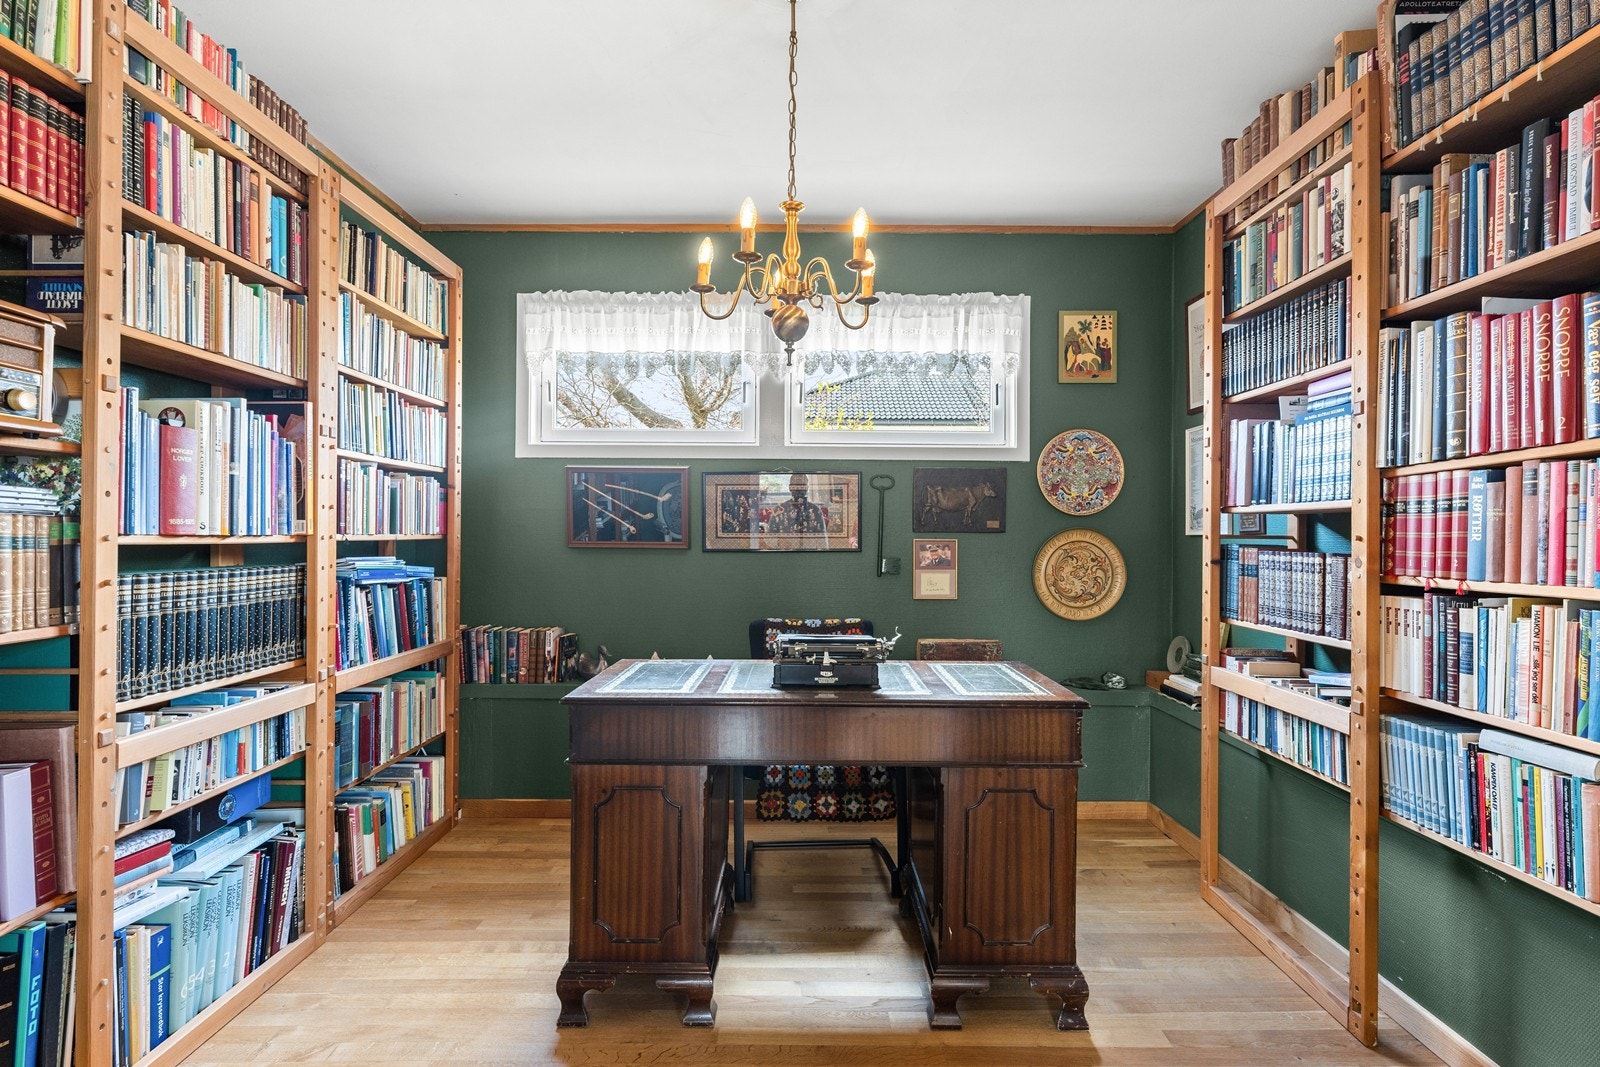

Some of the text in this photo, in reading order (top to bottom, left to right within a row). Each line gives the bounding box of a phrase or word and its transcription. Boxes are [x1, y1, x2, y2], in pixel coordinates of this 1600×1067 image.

[1398, 53, 1409, 85] FILM
[1569, 153, 1578, 197] FLØGSTAD
[1496, 152, 1505, 262] GEORGE ORWELL 1984
[1568, 202, 1577, 234] FIMBUL
[1534, 313, 1551, 382] SNORRE
[1586, 318, 1600, 404] Vær deg selv
[1555, 306, 1570, 430] SNORRE 2
[1471, 494, 1482, 542] RØTTER
[1532, 610, 1541, 638] HAAKON
[1532, 641, 1540, 652] LIE
[1532, 670, 1540, 681] jeg
[1492, 790, 1498, 802] OM
[281, 865, 292, 906] MUNCH
[196, 966, 206, 982] 4
[208, 960, 216, 976] 3
[223, 952, 230, 968] 2
[180, 978, 188, 998] 6
[188, 973, 197, 990] 5
[28, 974, 40, 1036] FOTO
[156, 994, 164, 1038] kryssordbok
